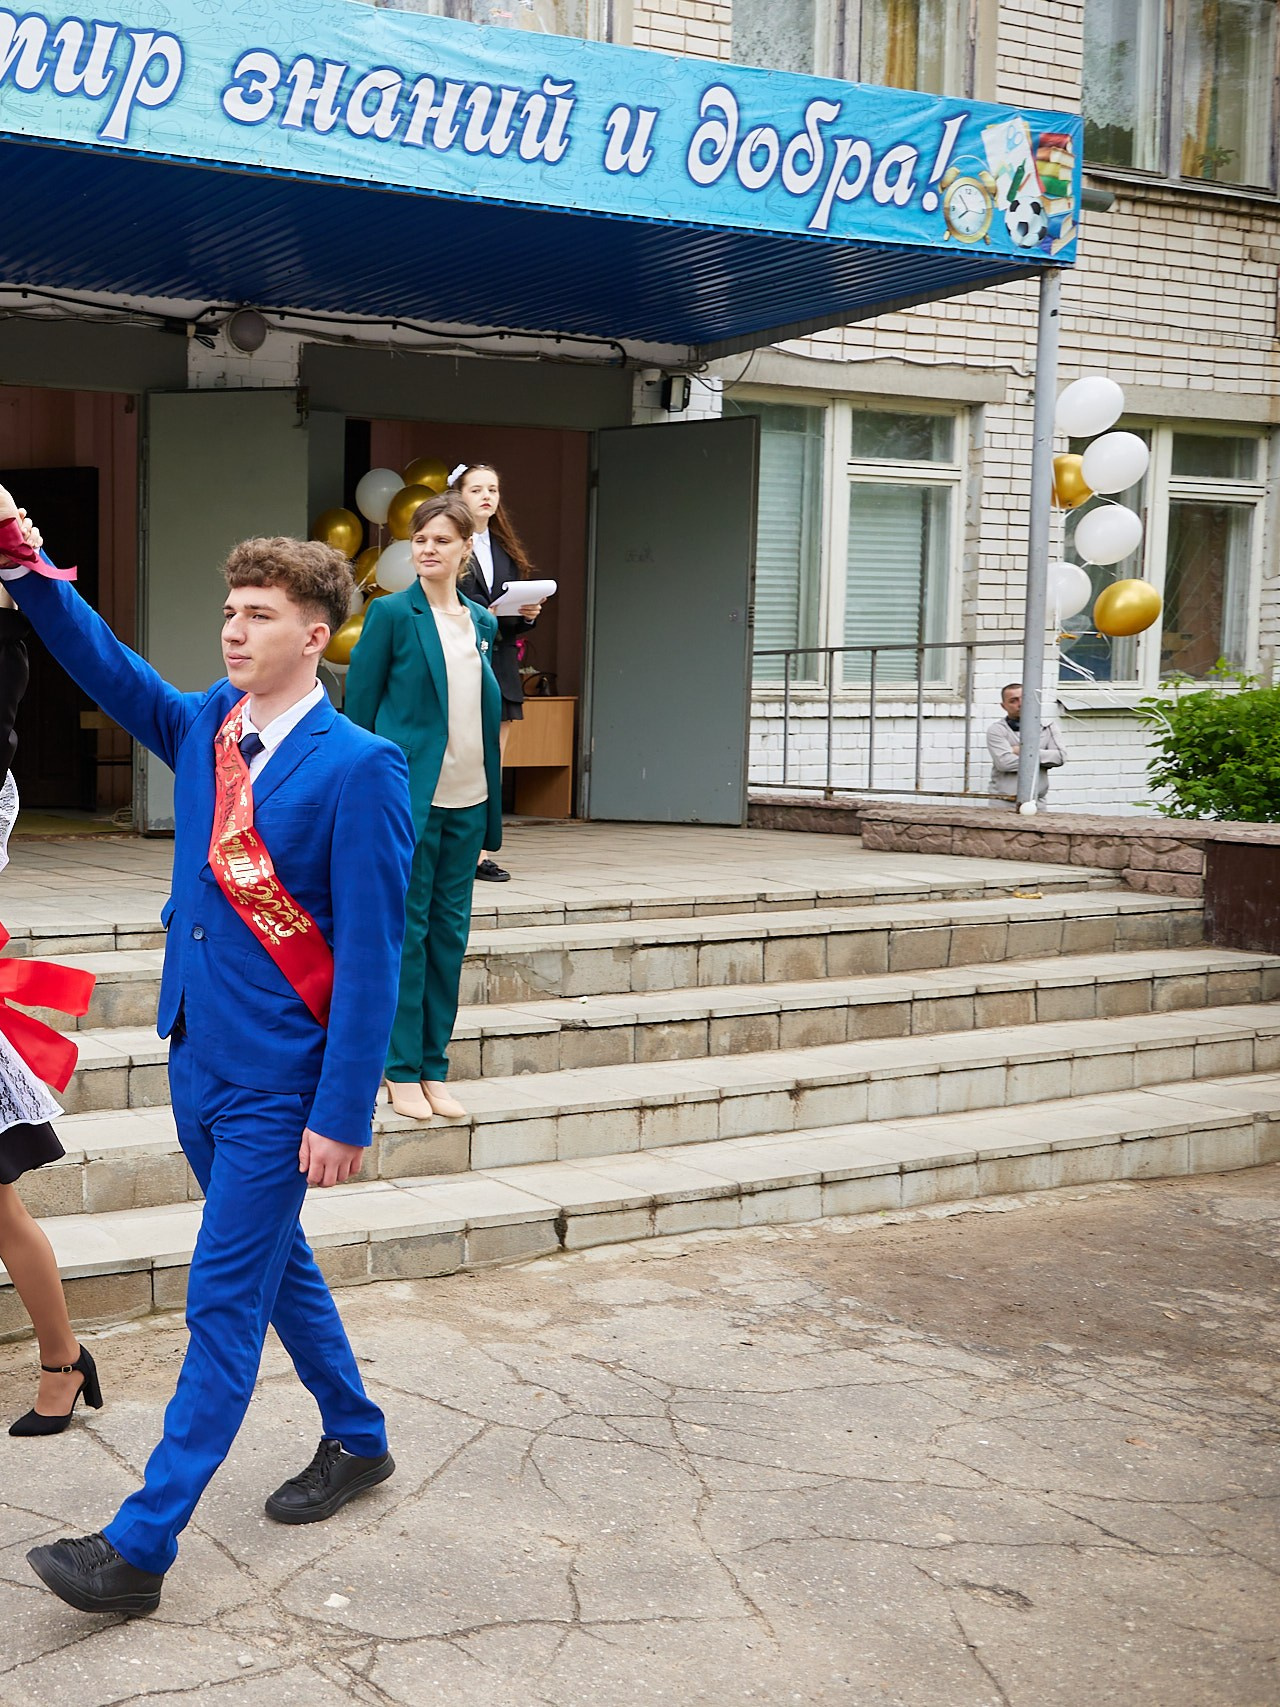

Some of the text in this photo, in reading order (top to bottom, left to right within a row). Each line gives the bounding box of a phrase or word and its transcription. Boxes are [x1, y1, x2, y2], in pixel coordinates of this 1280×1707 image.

[221, 48, 577, 166] знаний
[603, 105, 659, 175] и
[686, 81, 969, 231] добра!
